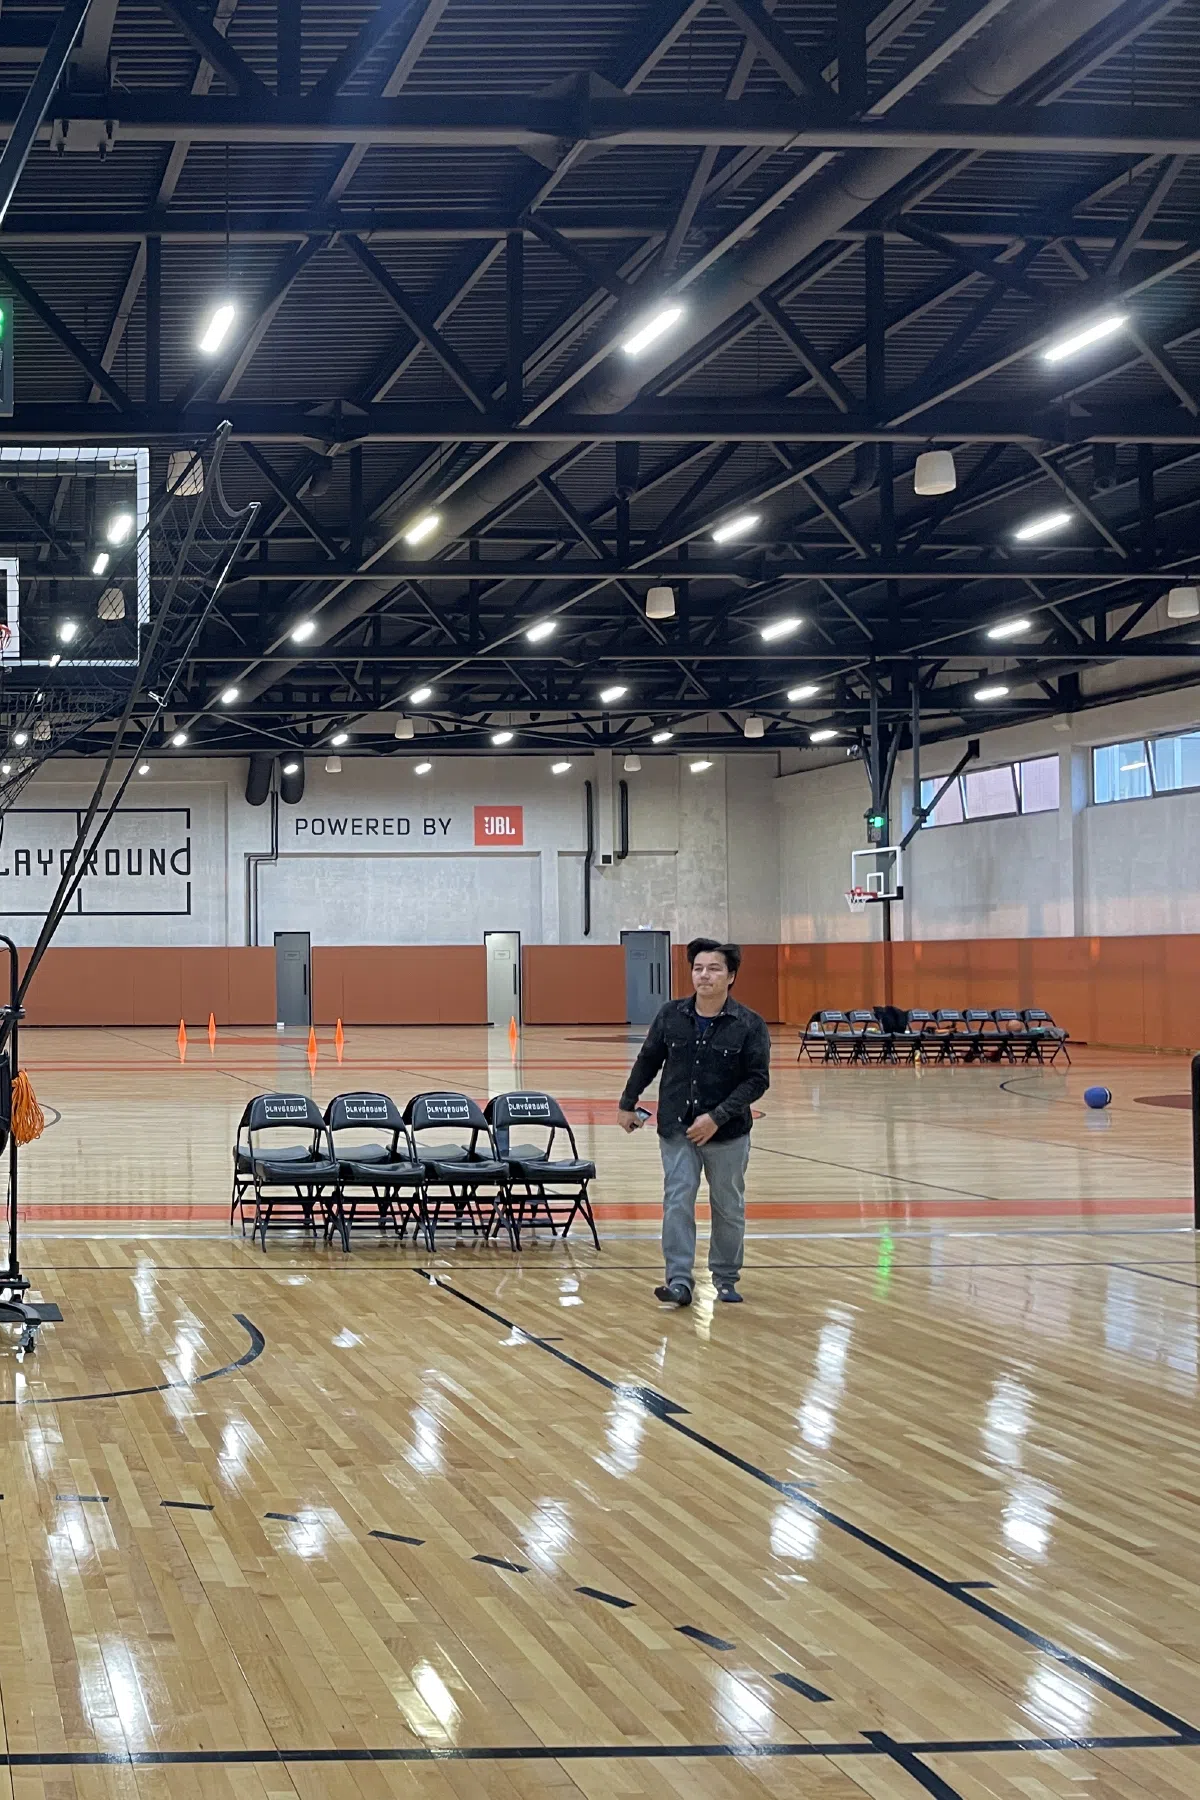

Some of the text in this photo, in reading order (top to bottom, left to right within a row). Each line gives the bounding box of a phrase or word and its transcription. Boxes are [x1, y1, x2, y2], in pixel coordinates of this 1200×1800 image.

[295, 816, 516, 835] POWERED BY JBL
